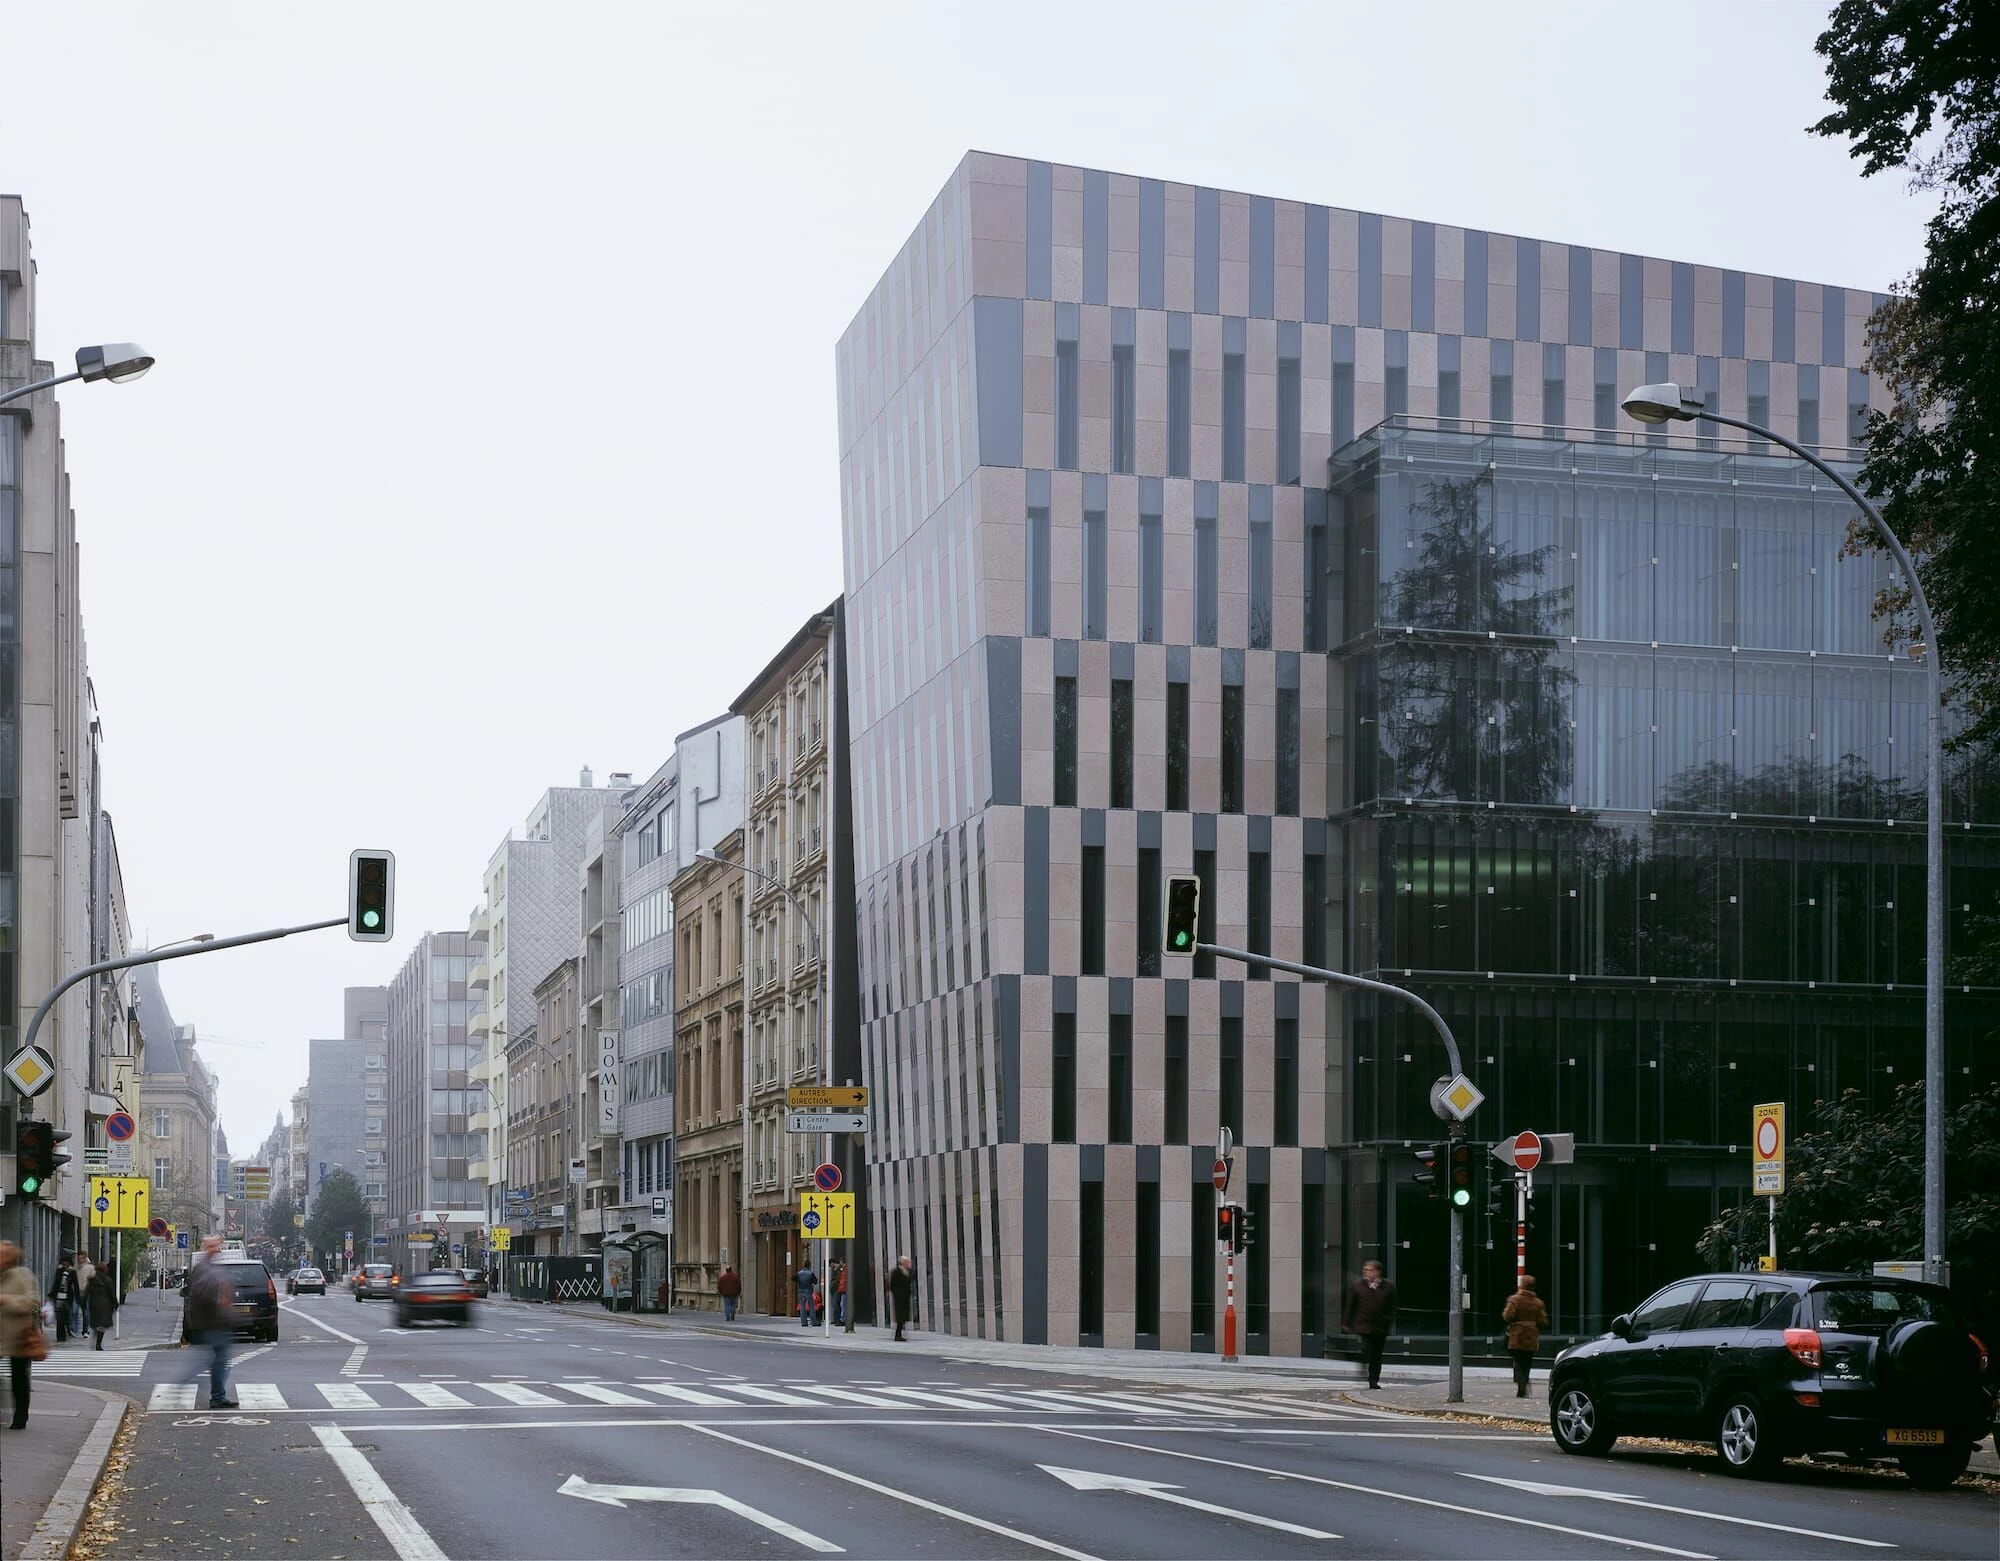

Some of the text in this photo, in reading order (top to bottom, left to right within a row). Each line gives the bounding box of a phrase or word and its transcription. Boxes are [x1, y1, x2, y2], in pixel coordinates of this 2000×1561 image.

[600, 1036, 618, 1121] DOMUS
[791, 1097, 833, 1105] DIRECTIONS
[1758, 1108, 1779, 1117] ZONE
[806, 1115, 829, 1123] Centre
[1895, 1430, 1938, 1442] XG 6519
